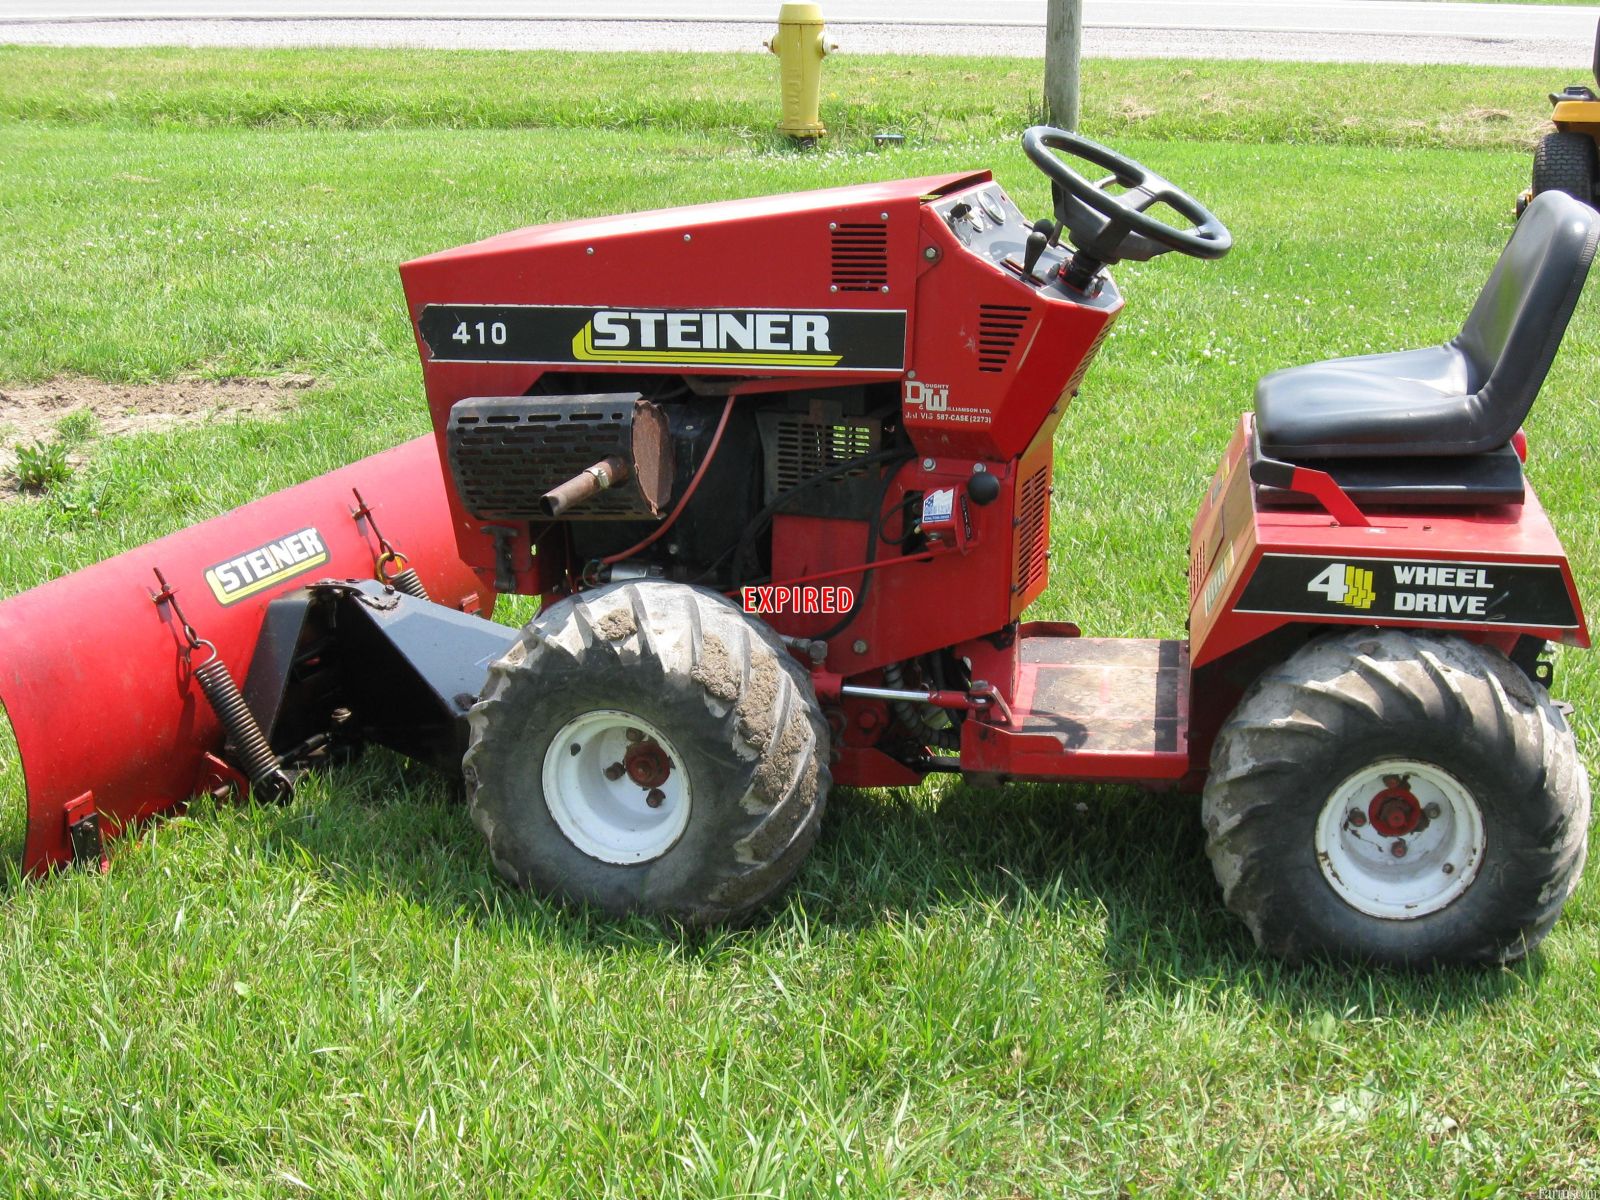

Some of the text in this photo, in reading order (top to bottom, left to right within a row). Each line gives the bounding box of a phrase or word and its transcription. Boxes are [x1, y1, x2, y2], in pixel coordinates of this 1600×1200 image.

[452, 321, 507, 344] 410
[593, 311, 832, 352] STEINER
[214, 527, 325, 593] STEINER
[1307, 563, 1350, 602] 4
[1393, 565, 1494, 589] WHEEL
[1394, 592, 1488, 616] DRIVE
